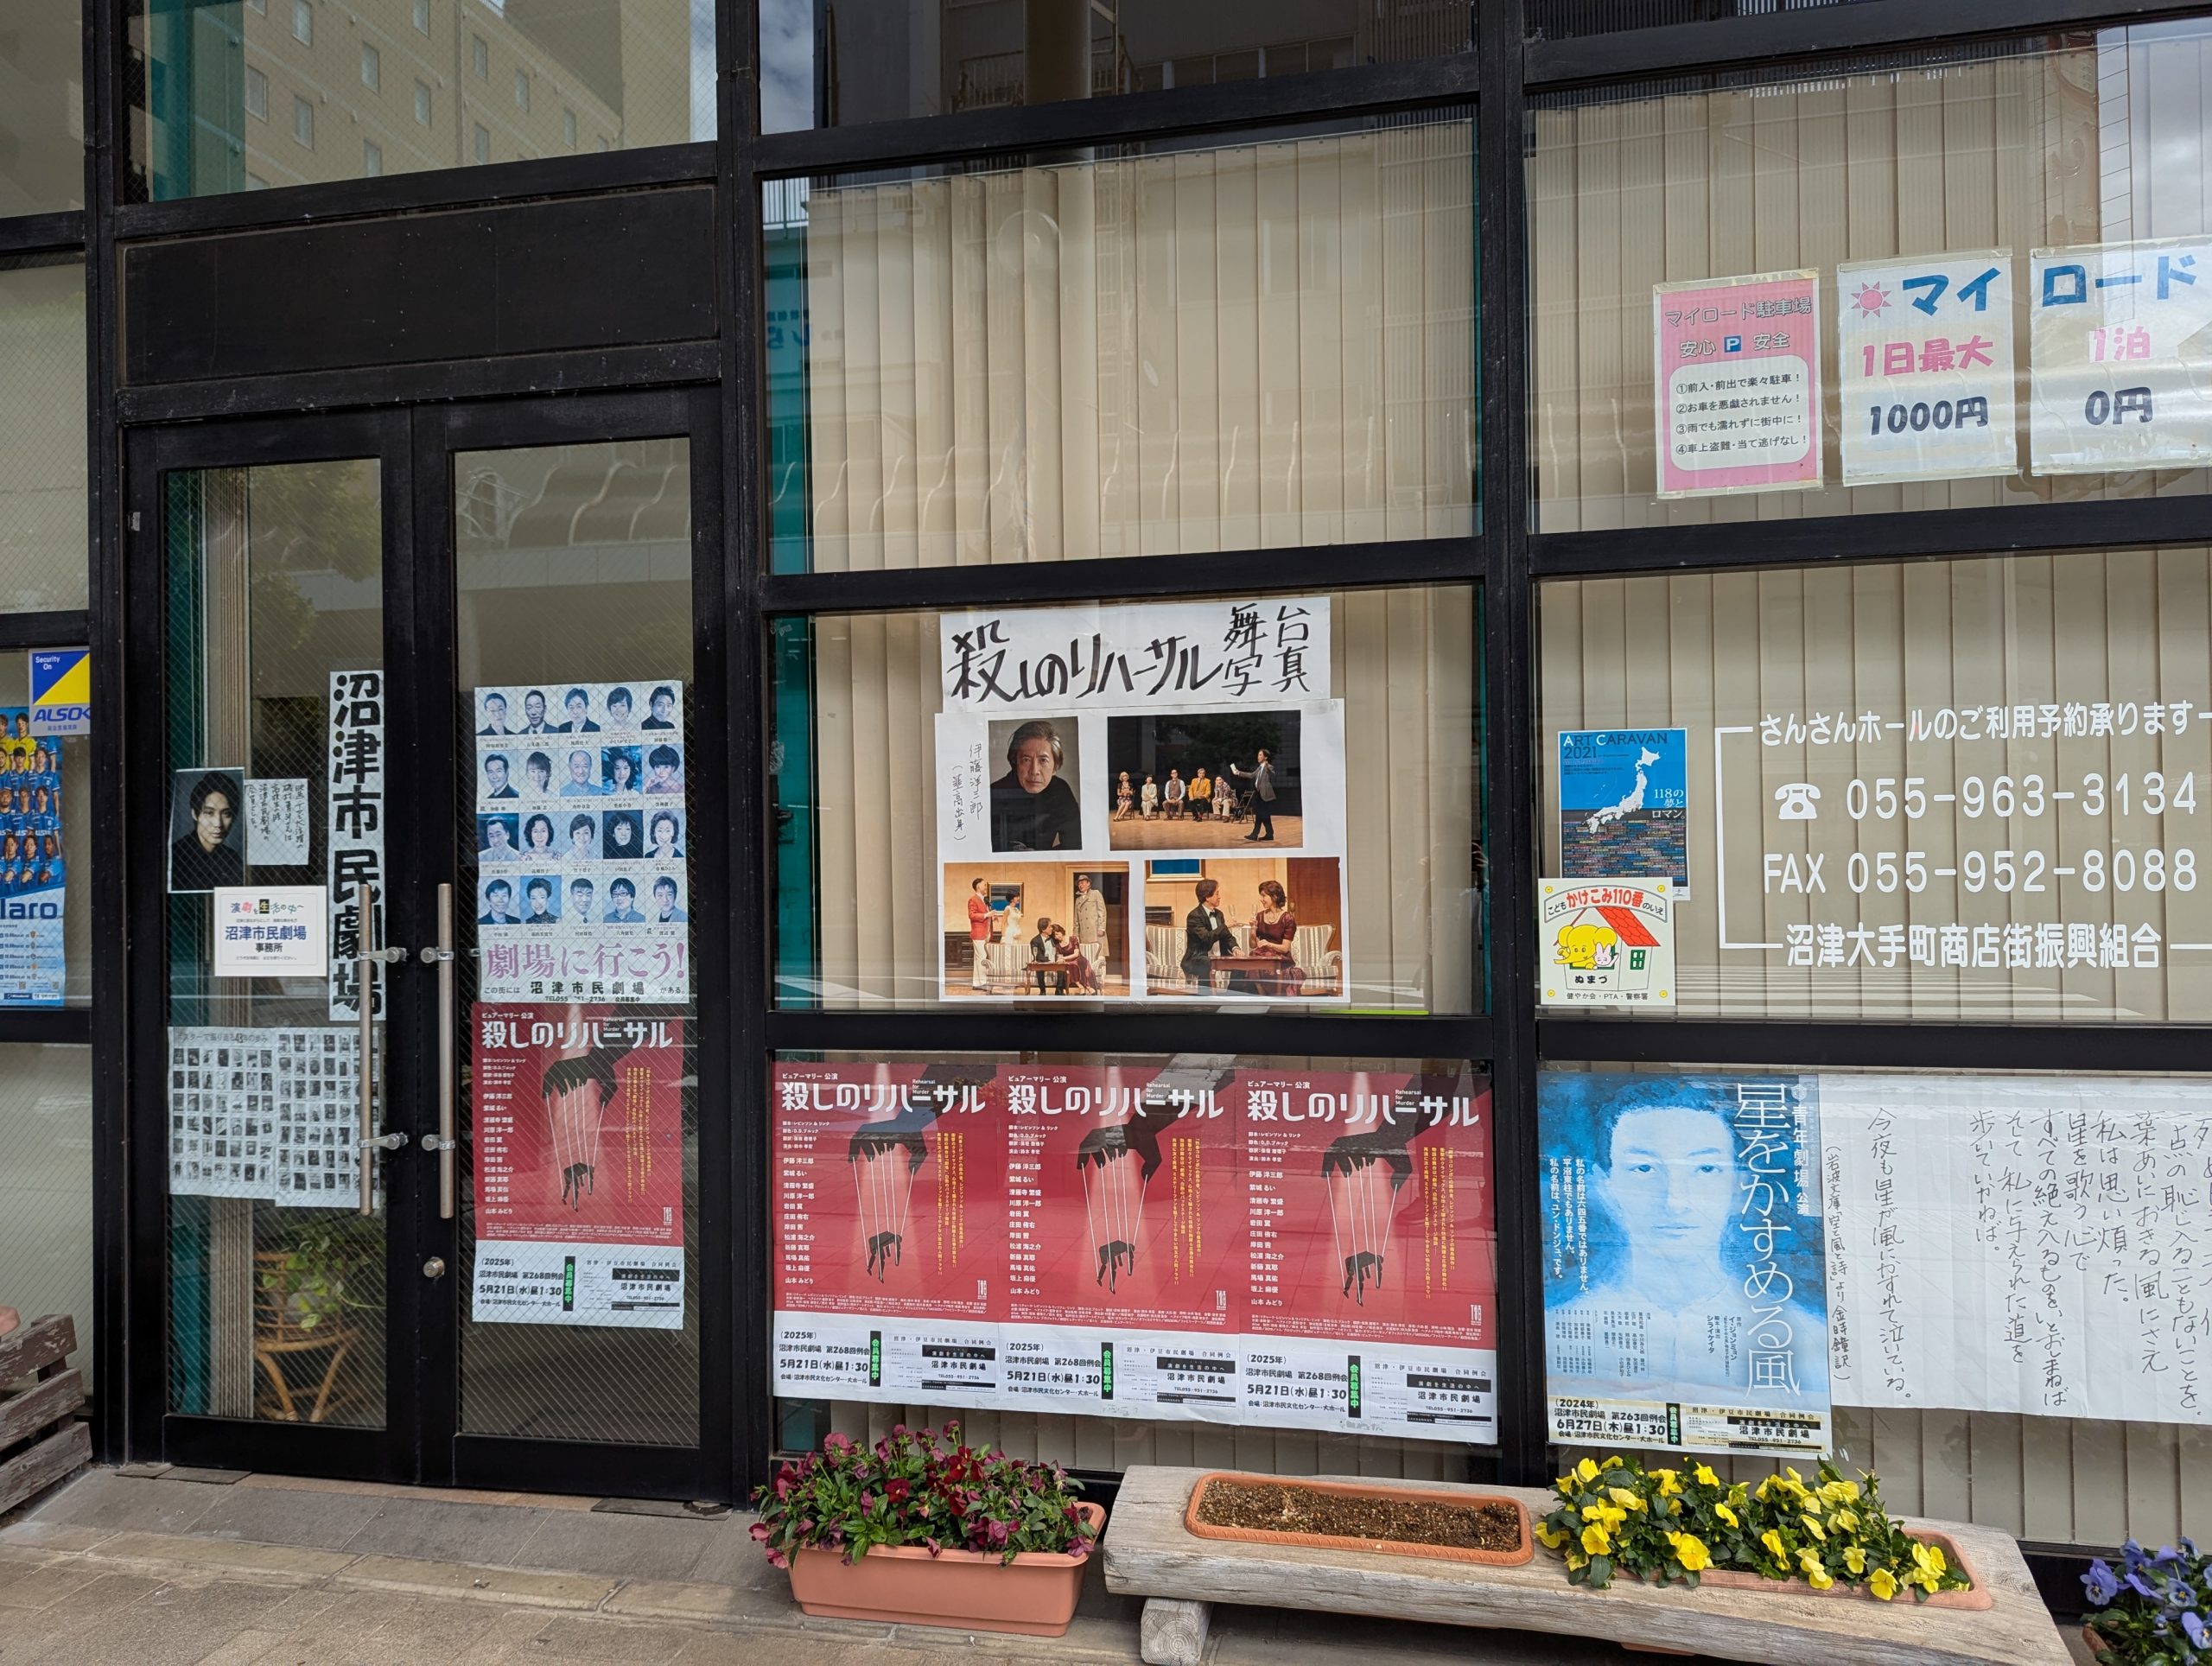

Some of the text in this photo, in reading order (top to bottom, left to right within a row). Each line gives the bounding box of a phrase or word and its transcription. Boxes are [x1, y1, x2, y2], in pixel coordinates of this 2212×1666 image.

[1902, 267, 2001, 315] マイ
[2042, 254, 2197, 308] ロード
[1665, 296, 1812, 327] マイロード駐車場
[1680, 339, 1716, 358] 安心
[1753, 331, 1790, 351] 安全
[1862, 334, 1994, 377] 1日最大
[2094, 329, 2151, 361] 1泊
[1870, 397, 1987, 436] 1000円
[2085, 386, 2153, 426] 0円
[946, 620, 1225, 703] 殺しのリハーサル
[1221, 646, 1311, 696] 写真
[1760, 699, 2195, 747] さんさんホールのご利用予約承ります
[1563, 733, 1668, 747] ART CARAVAN
[1564, 746, 1597, 760] 2021
[1654, 788, 1684, 798] 118の
[1846, 771, 2197, 820] 055-963-3134
[1651, 810, 1686, 820] ロマン。
[1764, 848, 2197, 895] FAX 055-952-8088
[226, 925, 307, 940] 沼津市民劇場
[256, 943, 283, 952] 事務所
[1786, 921, 2162, 970] 沼津大手町商店街振興組合
[486, 942, 685, 979] 劇場に行こう!
[531, 981, 645, 995] 沼津市民劇場
[1574, 975, 1608, 984] ぬまづ
[482, 1021, 673, 1049] 殺しのリハーサル
[782, 1082, 986, 1114] 殺しのリハーサル
[1008, 1084, 1224, 1118] 殺しのリハーサル
[1247, 1091, 1479, 1126] 殺しのリハーサル
[1791, 1106, 1810, 1215] 青年劇場 公演
[2064, 1112, 2097, 1272] 星を歌う心で
[1734, 1083, 1801, 1398] 星をかすめる風
[1005, 1355, 1049, 1365] 沼津市民劇場
[1166, 1372, 1225, 1384] 沼津市民劇場
[1554, 1399, 1599, 1409] (2024年)
[1554, 1408, 1606, 1420] 沼津市民劇場
[1739, 1426, 1810, 1439] 沼津市民劇場
